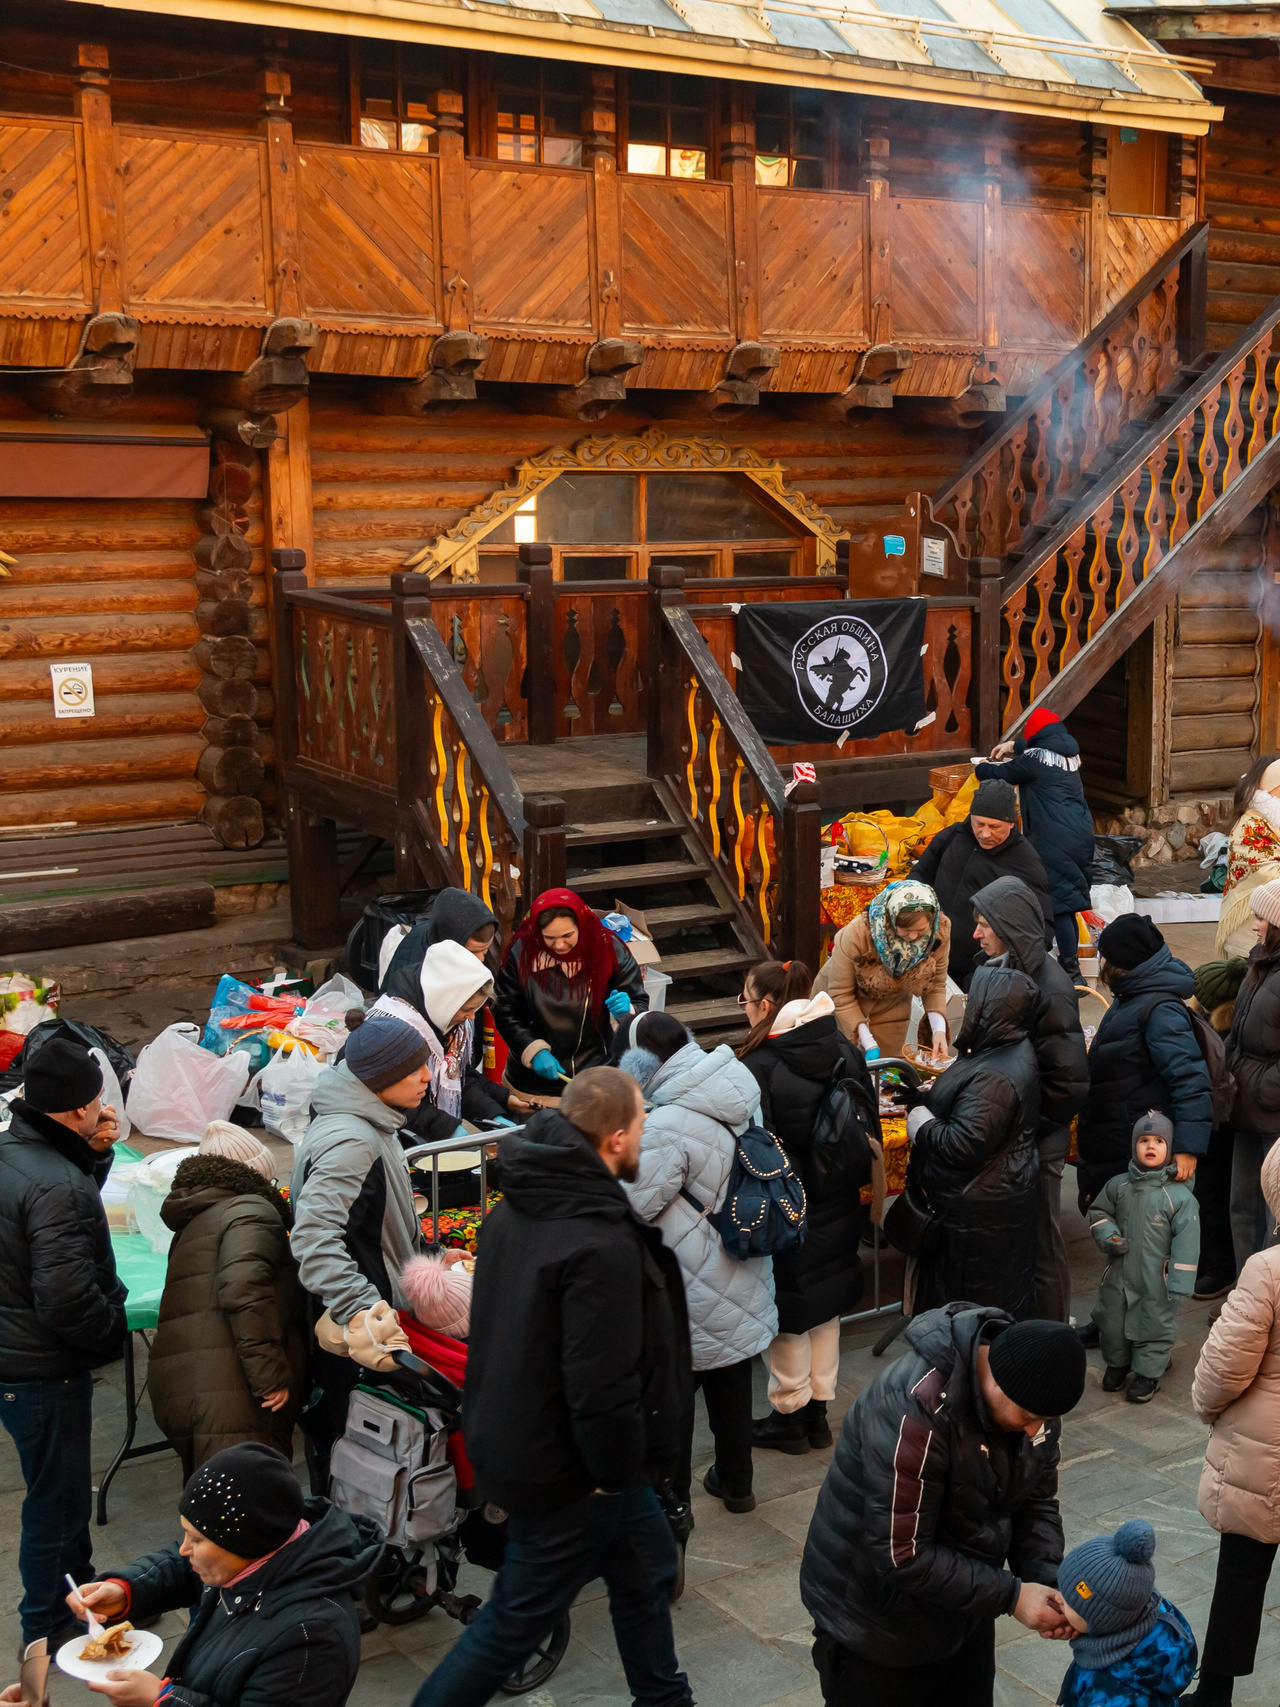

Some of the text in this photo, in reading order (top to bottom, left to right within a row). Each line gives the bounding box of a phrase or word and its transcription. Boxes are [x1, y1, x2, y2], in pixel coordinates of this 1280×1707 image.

[797, 621, 880, 670] РУССКАЯ ОБЩИНА
[813, 699, 874, 724] БАЛАШИХА
